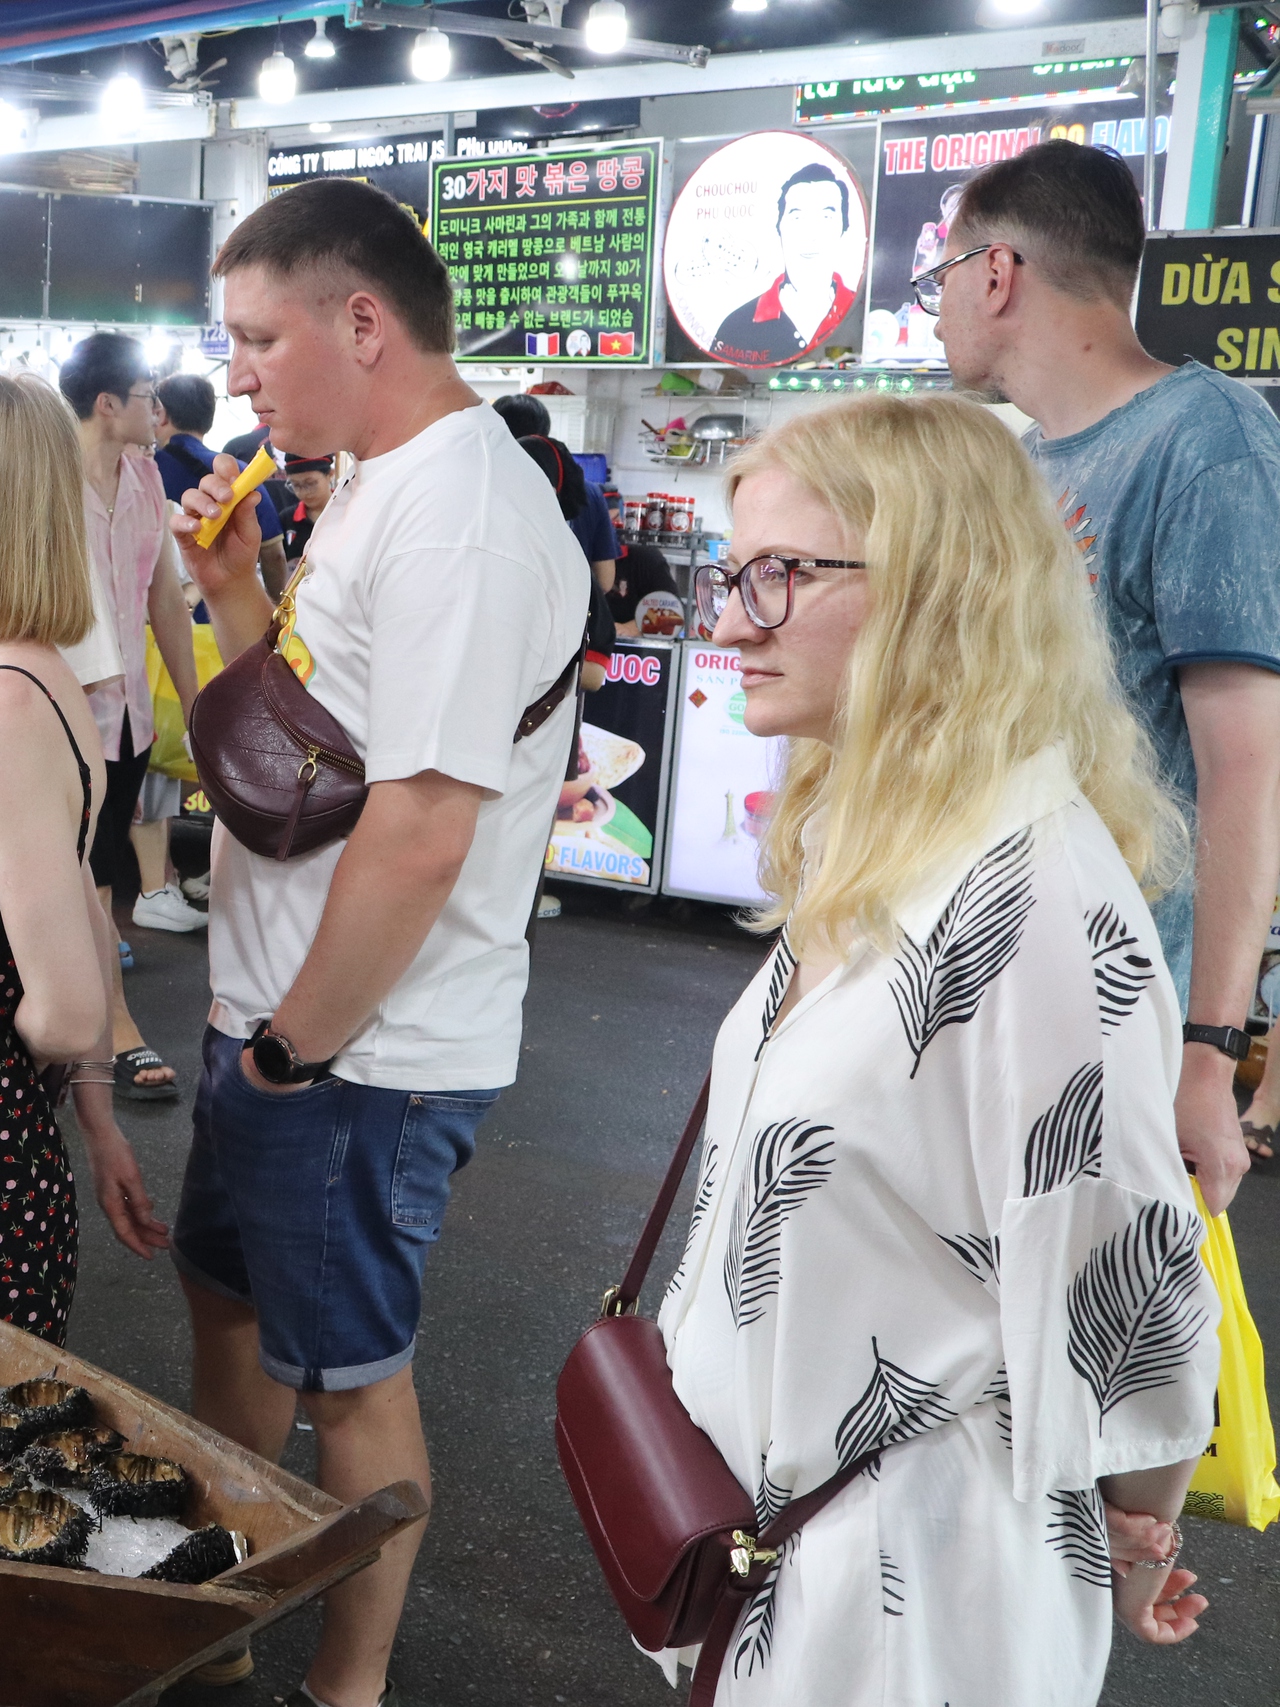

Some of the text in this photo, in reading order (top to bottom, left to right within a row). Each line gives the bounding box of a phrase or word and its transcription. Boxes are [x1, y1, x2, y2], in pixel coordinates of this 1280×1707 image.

[268, 152, 301, 177] CÔNG
[302, 152, 320, 173] TY
[883, 137, 928, 176] THE
[442, 155, 646, 201] 30가지 맛 볶은 땅콩
[695, 181, 758, 198] CHOUCHOU
[439, 206, 646, 237] 도미니크 사마린과 그의 가족과 함께 전통
[521, 236, 566, 257] 땅콩으로
[570, 233, 605, 254] 베트남
[609, 232, 644, 253] 사람의
[497, 261, 550, 282] 만들었으며
[553, 258, 611, 280] 오날까지
[615, 257, 641, 278] 30가
[1161, 253, 1251, 305] DỪA
[476, 286, 496, 307] 맛을
[500, 285, 542, 306] 출시하여
[546, 283, 602, 305] 관광객들이
[606, 282, 642, 303] 푸꾸옥
[509, 310, 520, 329] 수
[523, 309, 545, 329] 없는
[548, 308, 594, 329] 브랜드가
[597, 308, 634, 328] 되었습
[602, 653, 661, 686] UOC
[559, 846, 643, 878] FLAVORS
